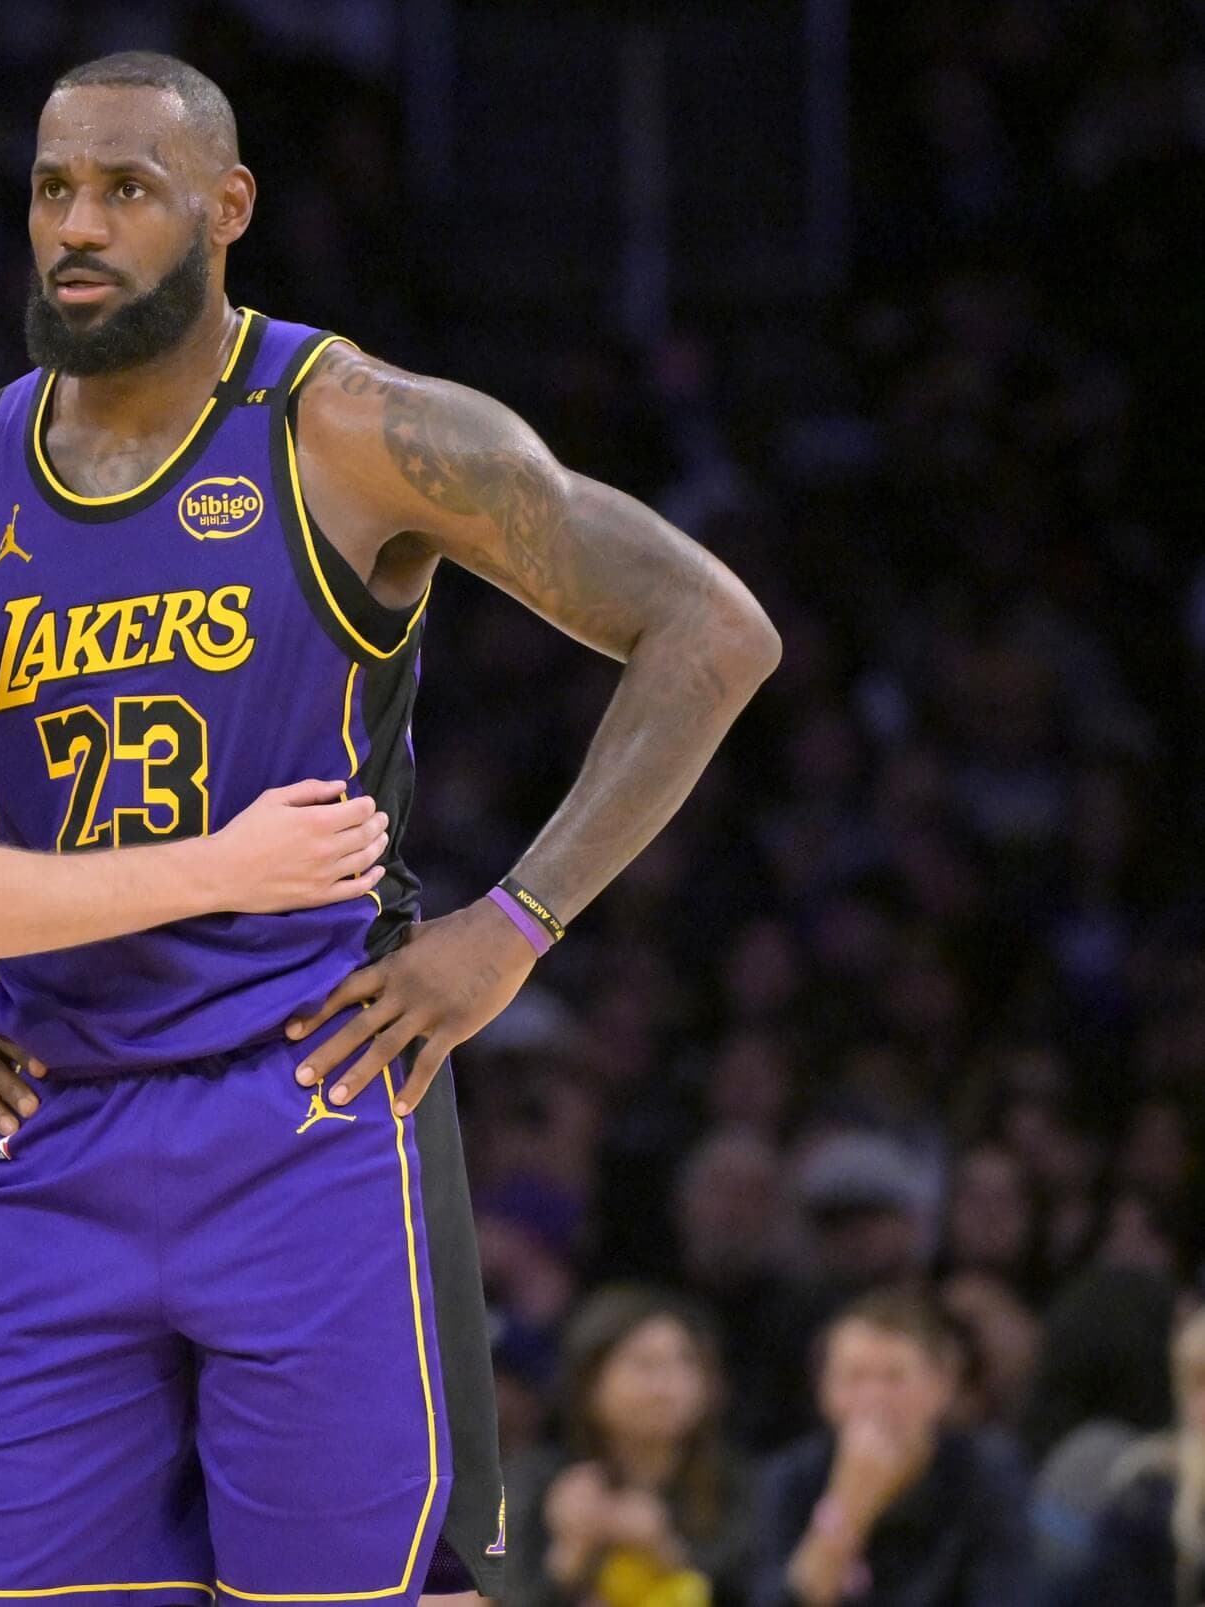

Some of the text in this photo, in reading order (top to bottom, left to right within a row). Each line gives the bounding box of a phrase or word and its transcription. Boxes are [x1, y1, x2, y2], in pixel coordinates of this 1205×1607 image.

[186, 493, 258, 519] bibigo
[200, 514, 230, 527] 비비고
[34, 694, 209, 855] 23
[517, 889, 551, 920] AKRON
